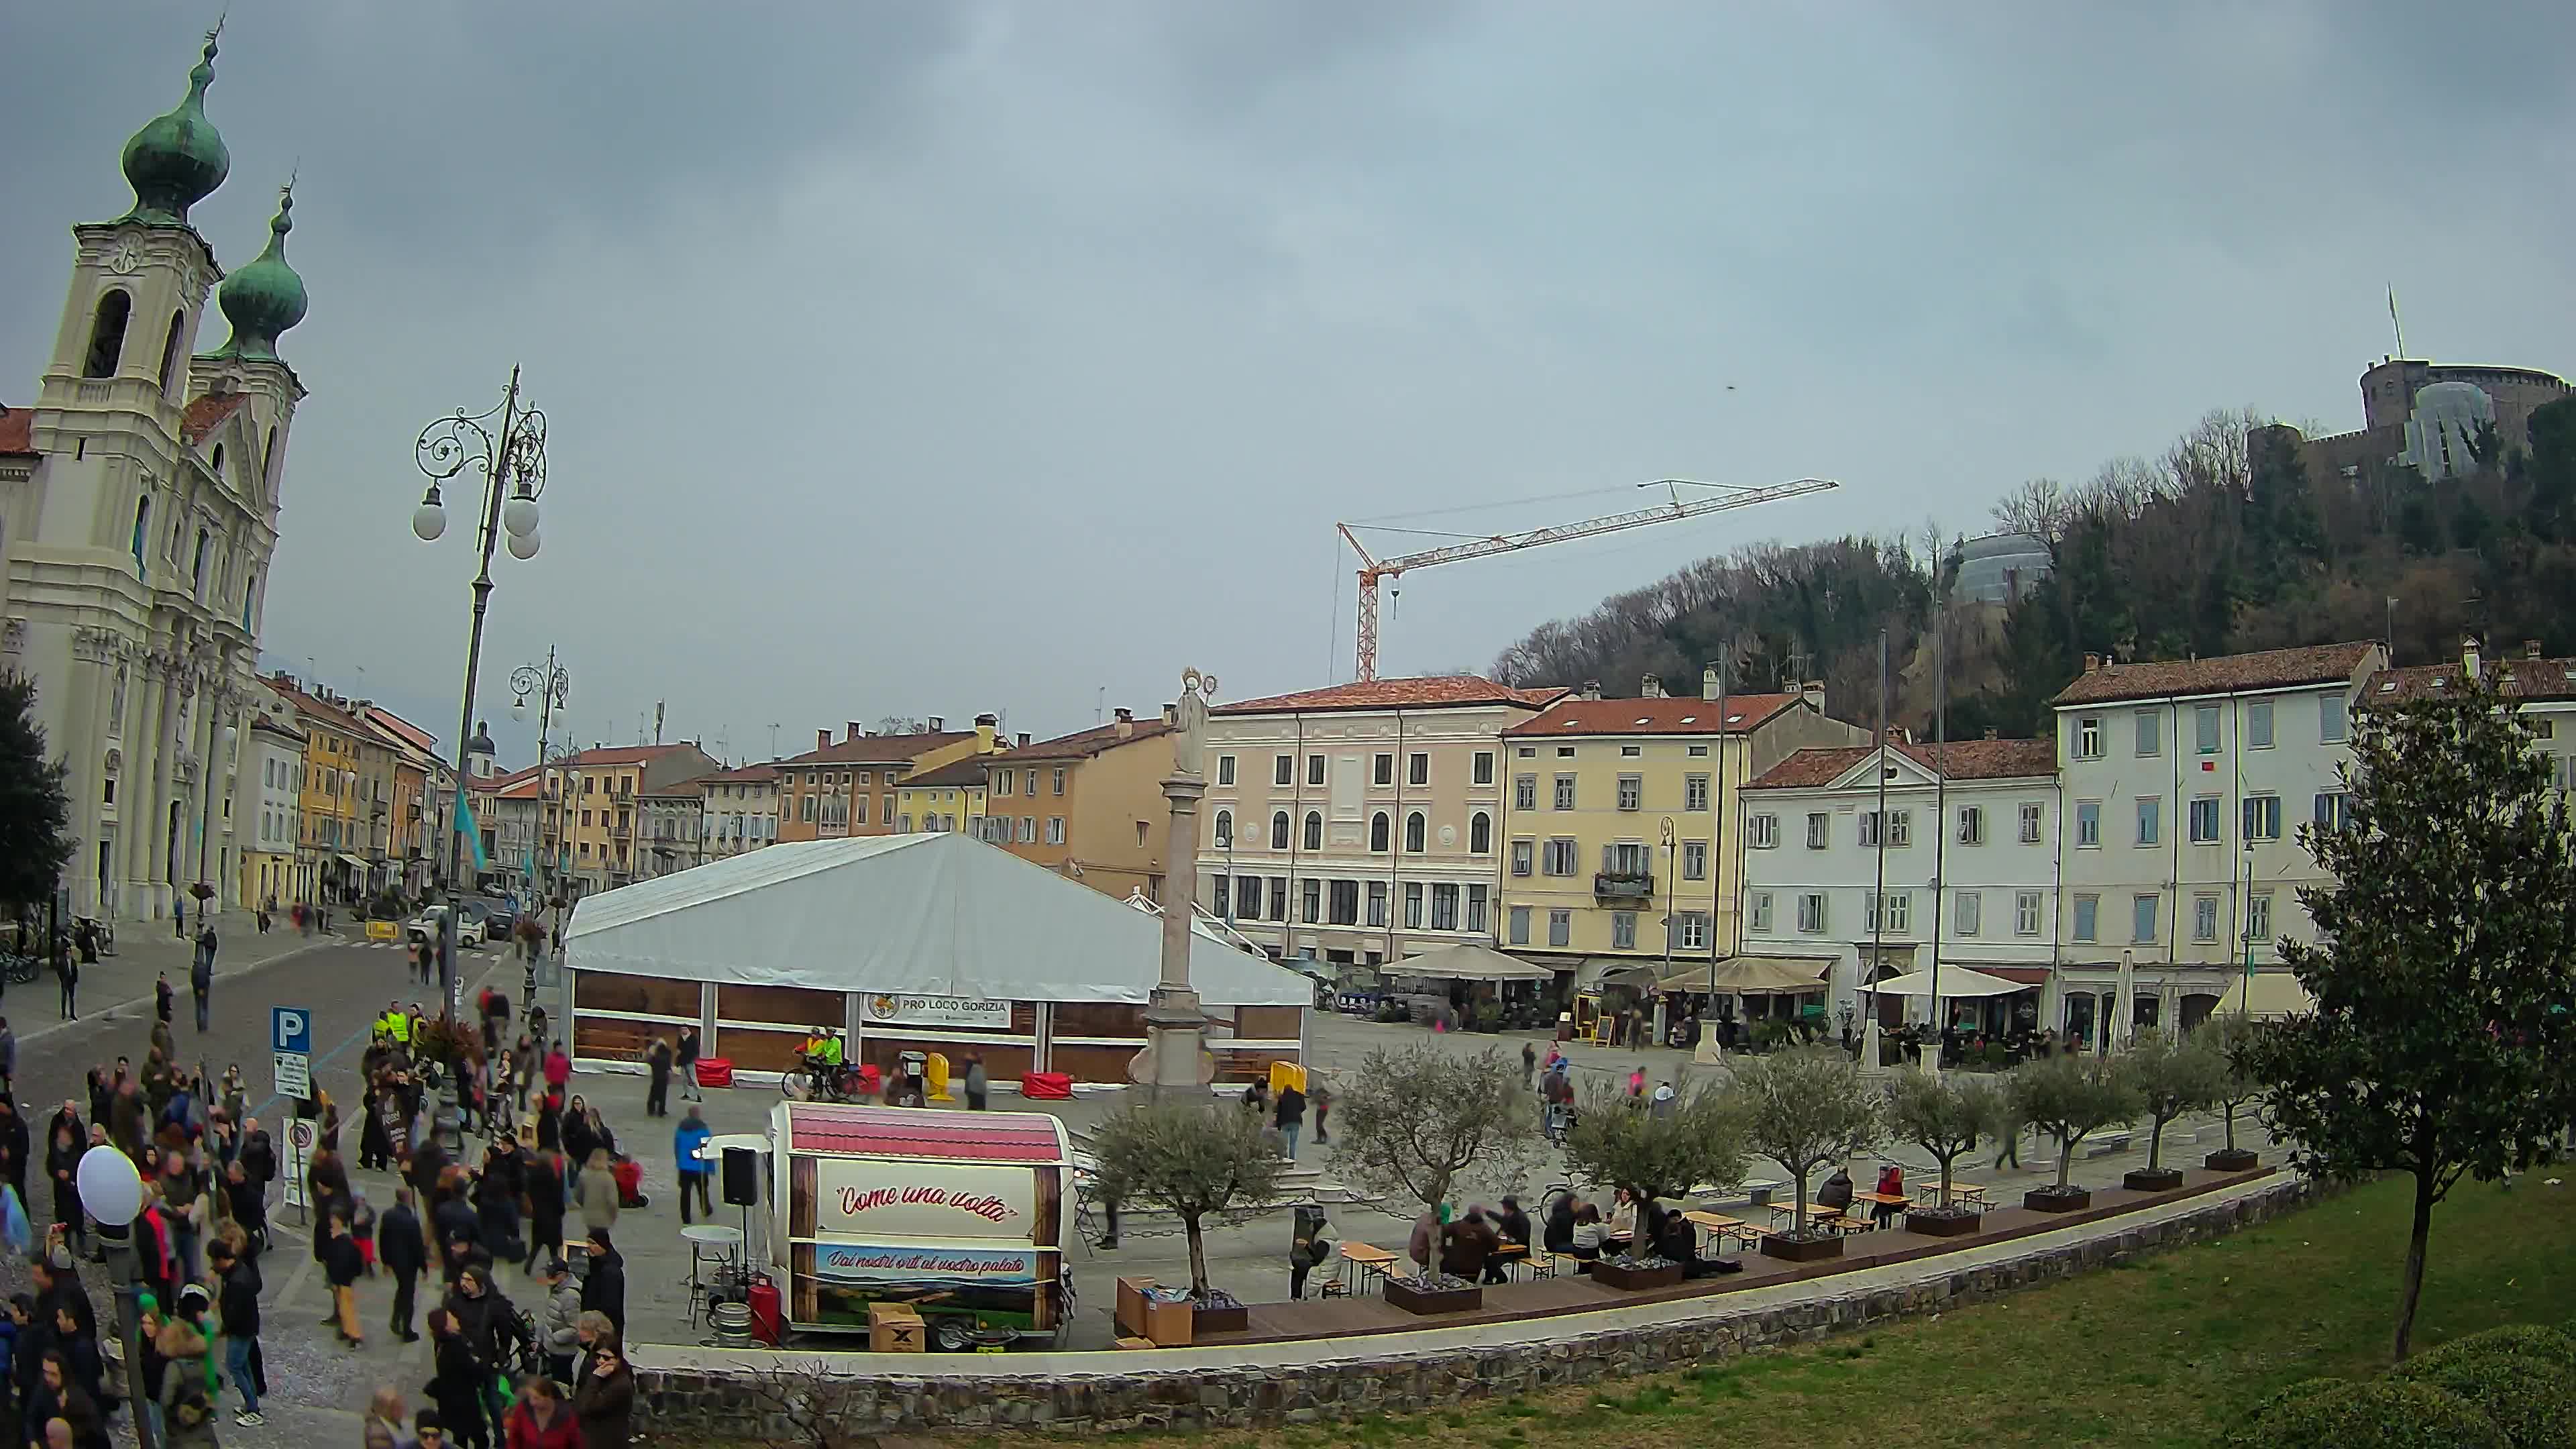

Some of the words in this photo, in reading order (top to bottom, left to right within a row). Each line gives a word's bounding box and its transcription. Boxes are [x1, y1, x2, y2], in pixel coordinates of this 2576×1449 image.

[903, 1000, 926, 1010] PRO
[928, 1000, 958, 1011] LOCO
[961, 1002, 1006, 1012] GORIZIA
[279, 1011, 303, 1046] P
[901, 1186, 947, 1205] una
[827, 1250, 858, 1267] Dai
[856, 1253, 896, 1269] nostri
[896, 1254, 924, 1269] orti
[921, 1255, 939, 1269] al
[938, 1257, 979, 1271] vostro
[977, 1256, 1024, 1276] palato
